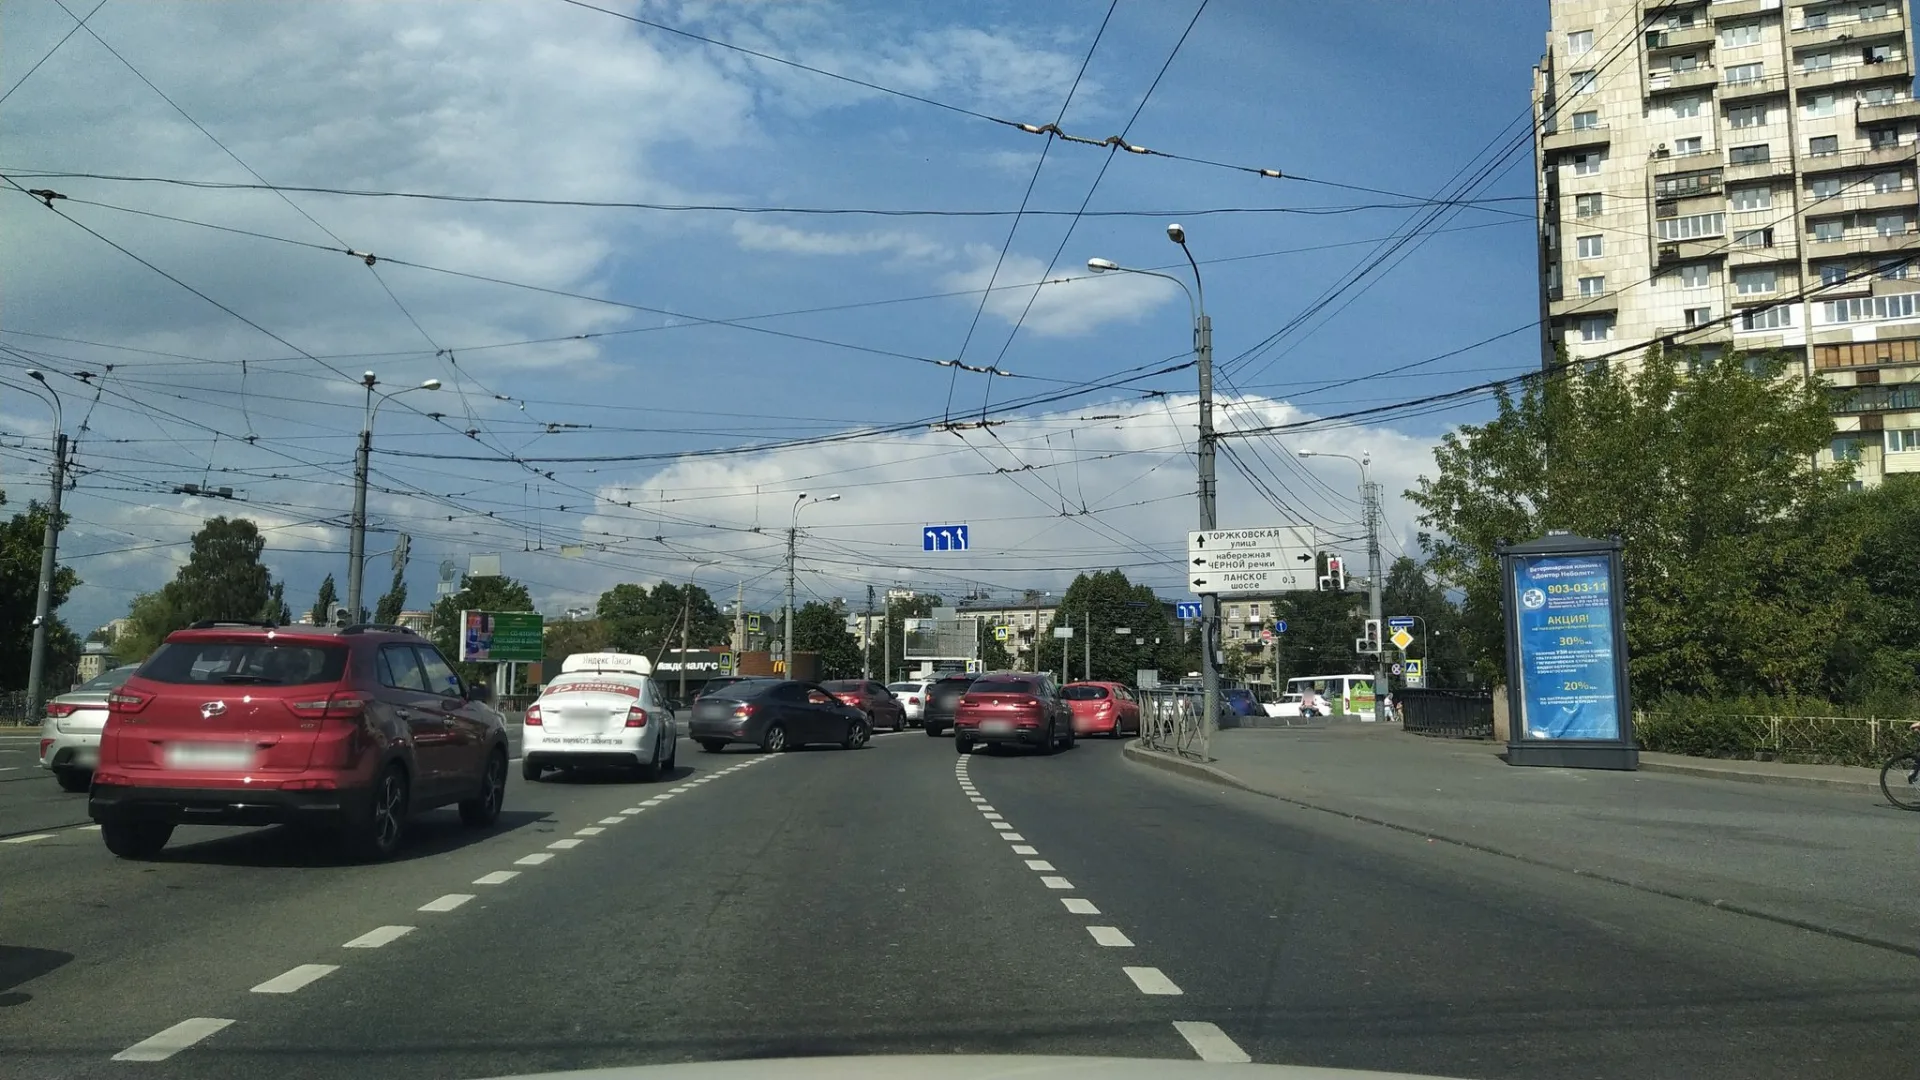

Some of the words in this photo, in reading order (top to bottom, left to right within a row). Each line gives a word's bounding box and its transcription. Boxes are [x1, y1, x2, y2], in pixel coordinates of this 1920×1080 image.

[1208, 530, 1280, 540] ТОРЖКОВСКАЯ
[1230, 540, 1257, 548] улица
[1216, 552, 1271, 560] набережная
[1208, 560, 1245, 569] ЧЕРНОЙ
[1247, 561, 1276, 569] речки
[1223, 573, 1268, 581] ЛАНСКОЕ
[1547, 582, 1607, 594] 903-03-11
[1547, 614, 1589, 625] АКЦИЯ!
[583, 655, 609, 665] Яндекс
[611, 656, 632, 665] Такси
